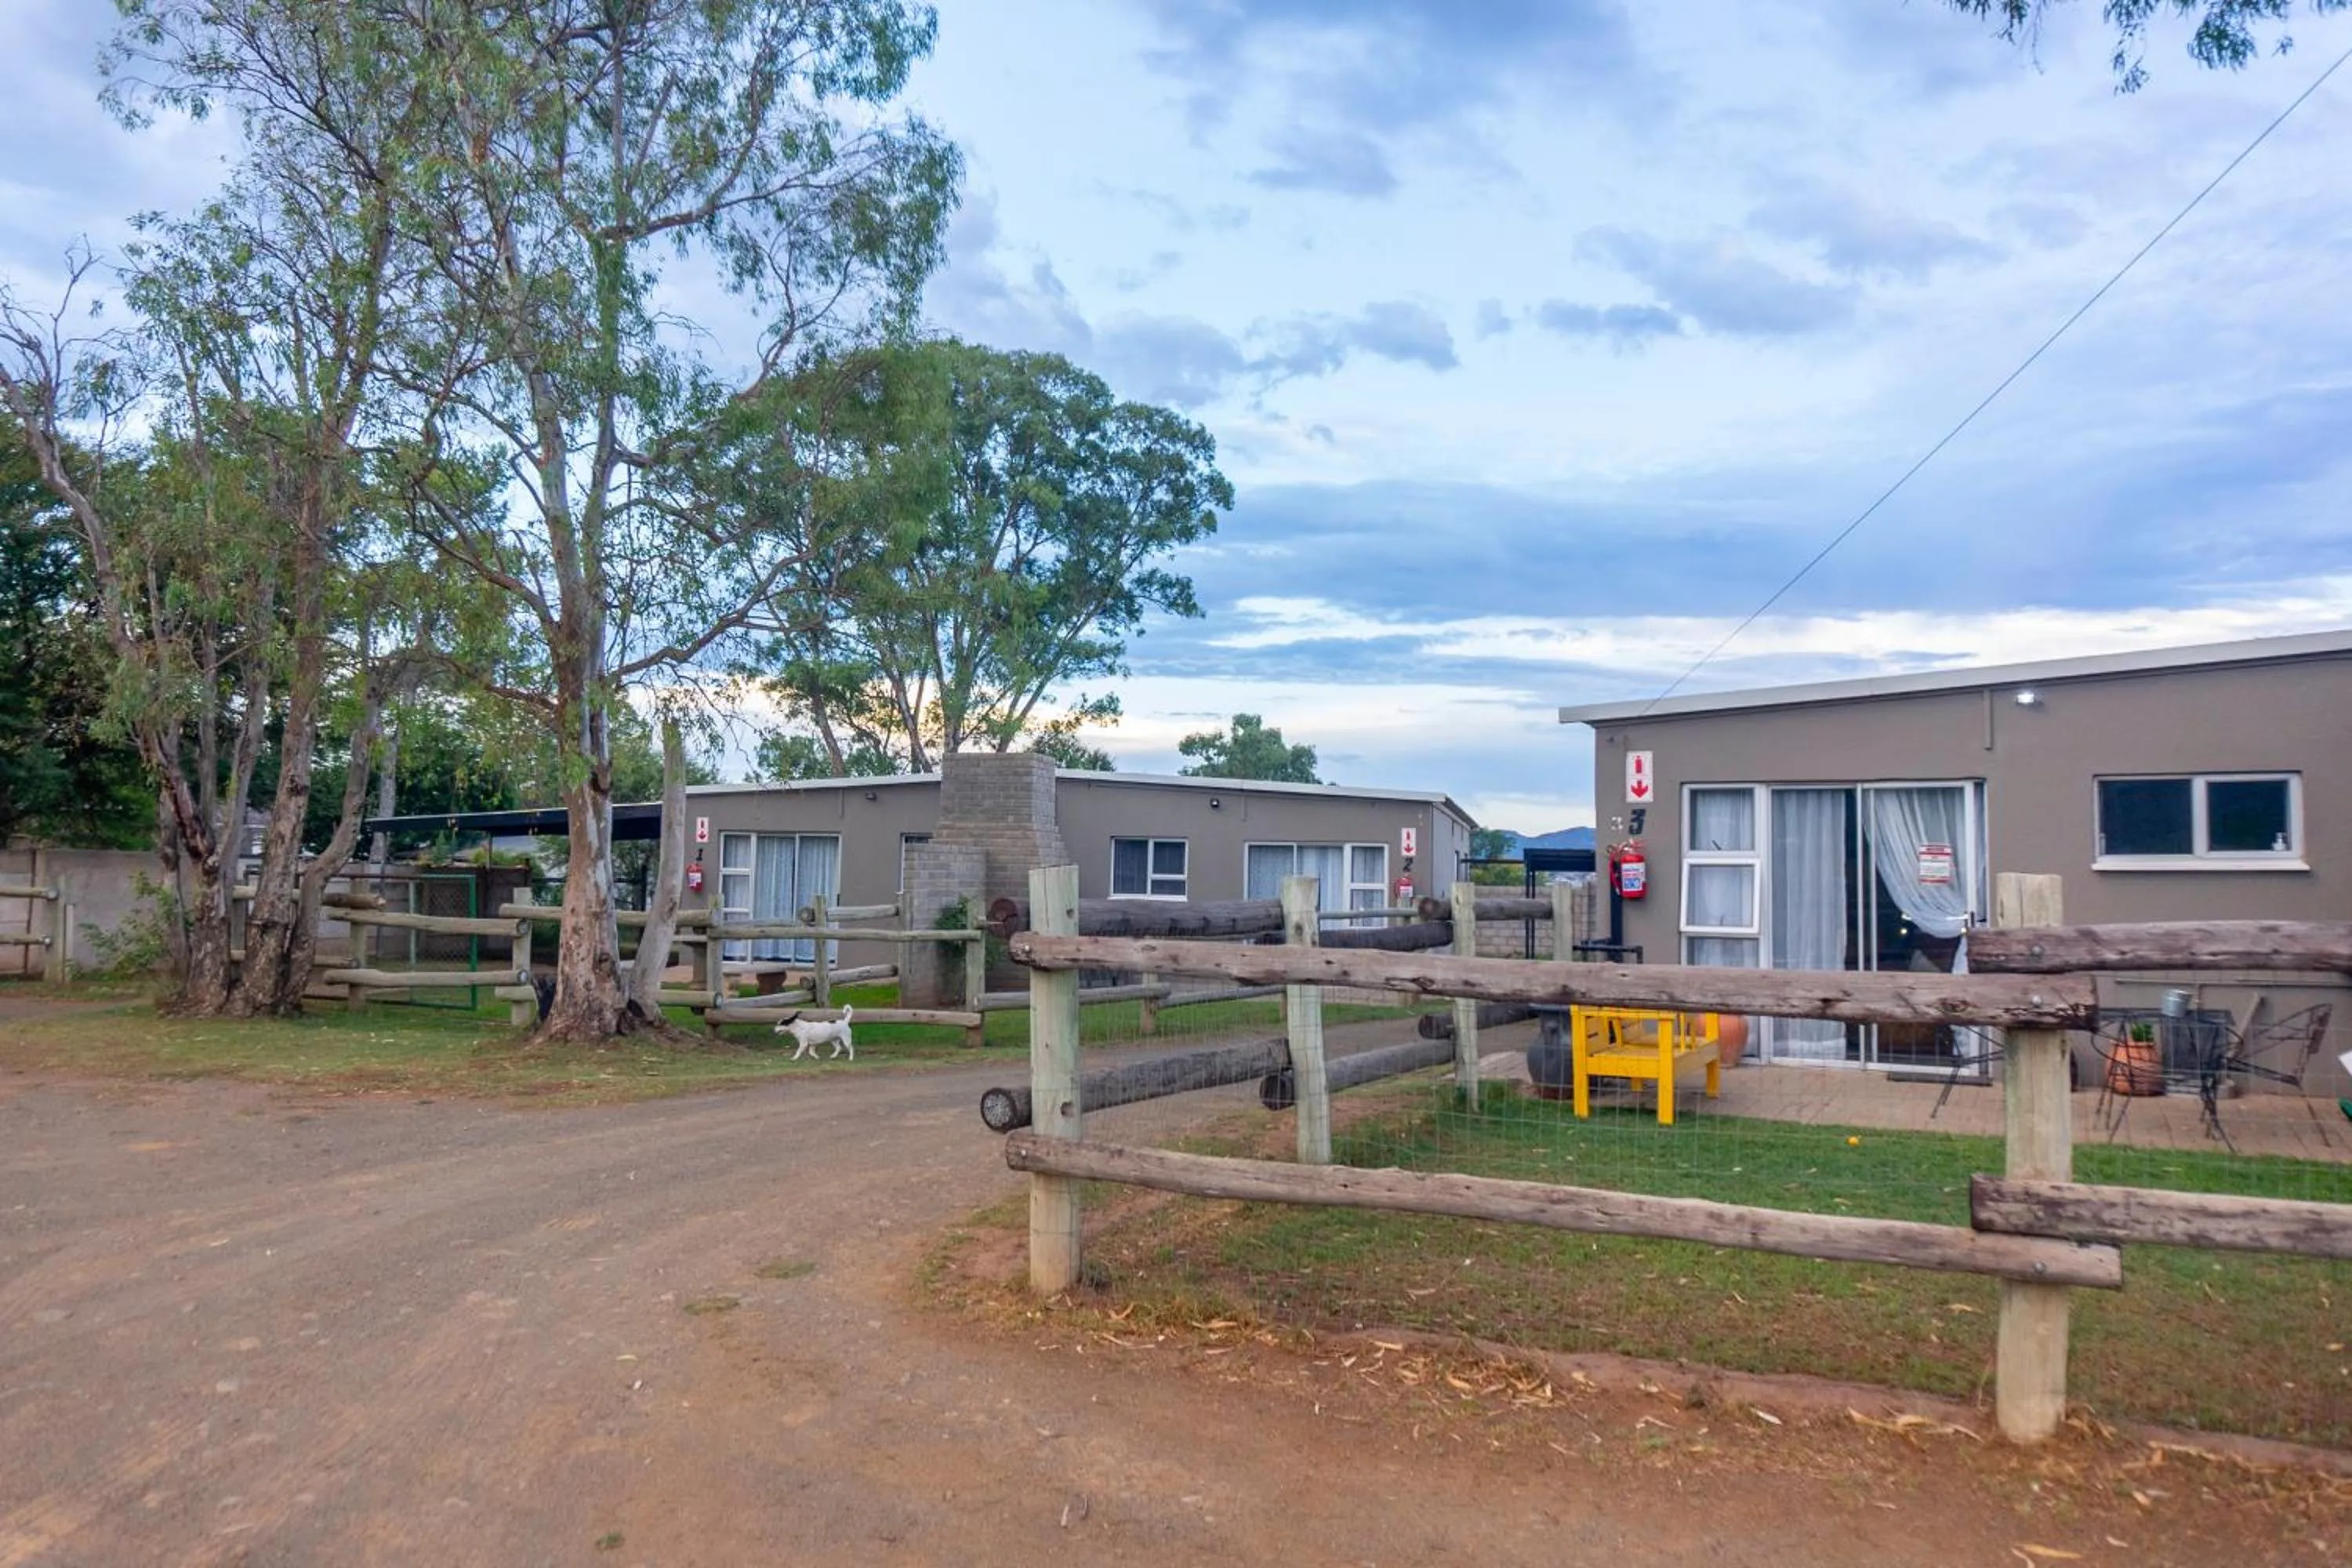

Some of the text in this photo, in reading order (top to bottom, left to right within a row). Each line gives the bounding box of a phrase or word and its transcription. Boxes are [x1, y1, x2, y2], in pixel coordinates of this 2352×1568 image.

[1628, 808, 1646, 835] 3
[695, 848, 703, 862] 1
[1403, 856, 1414, 872] 2
